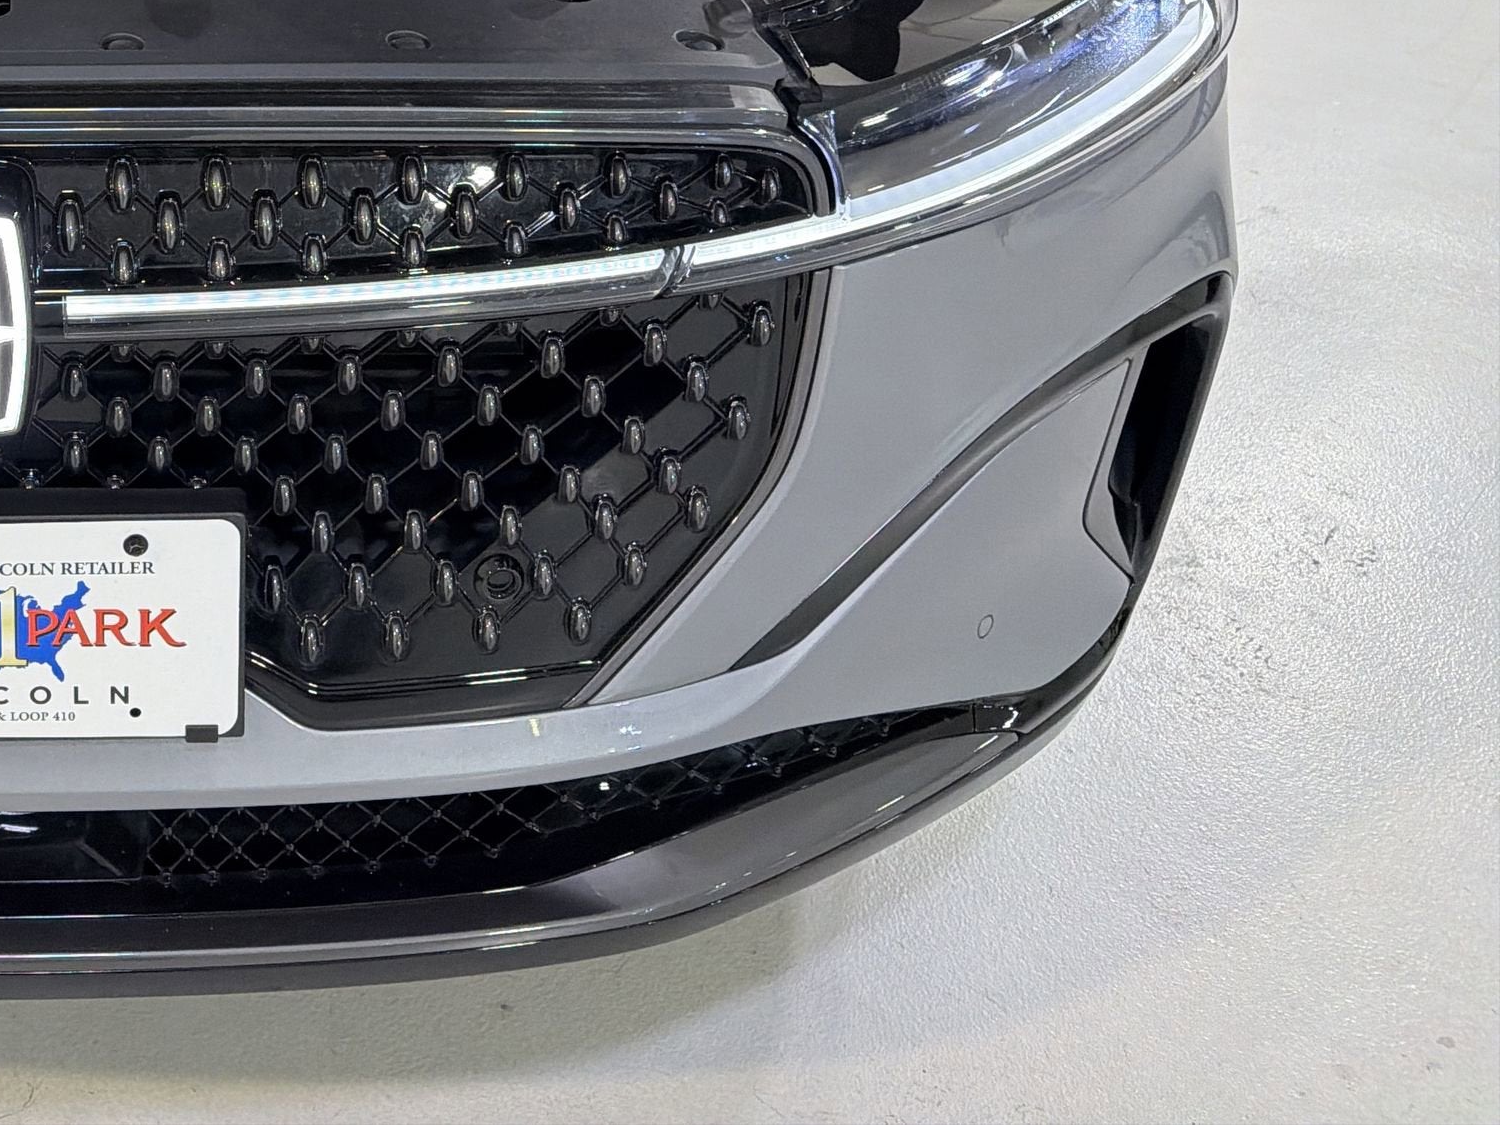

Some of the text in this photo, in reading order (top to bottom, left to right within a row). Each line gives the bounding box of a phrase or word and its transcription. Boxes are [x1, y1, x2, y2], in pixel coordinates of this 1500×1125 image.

[61, 561, 156, 575] RETAILER
[25, 608, 188, 648] PARK
[10, 711, 49, 721] LOOP
[52, 711, 76, 721] 410
